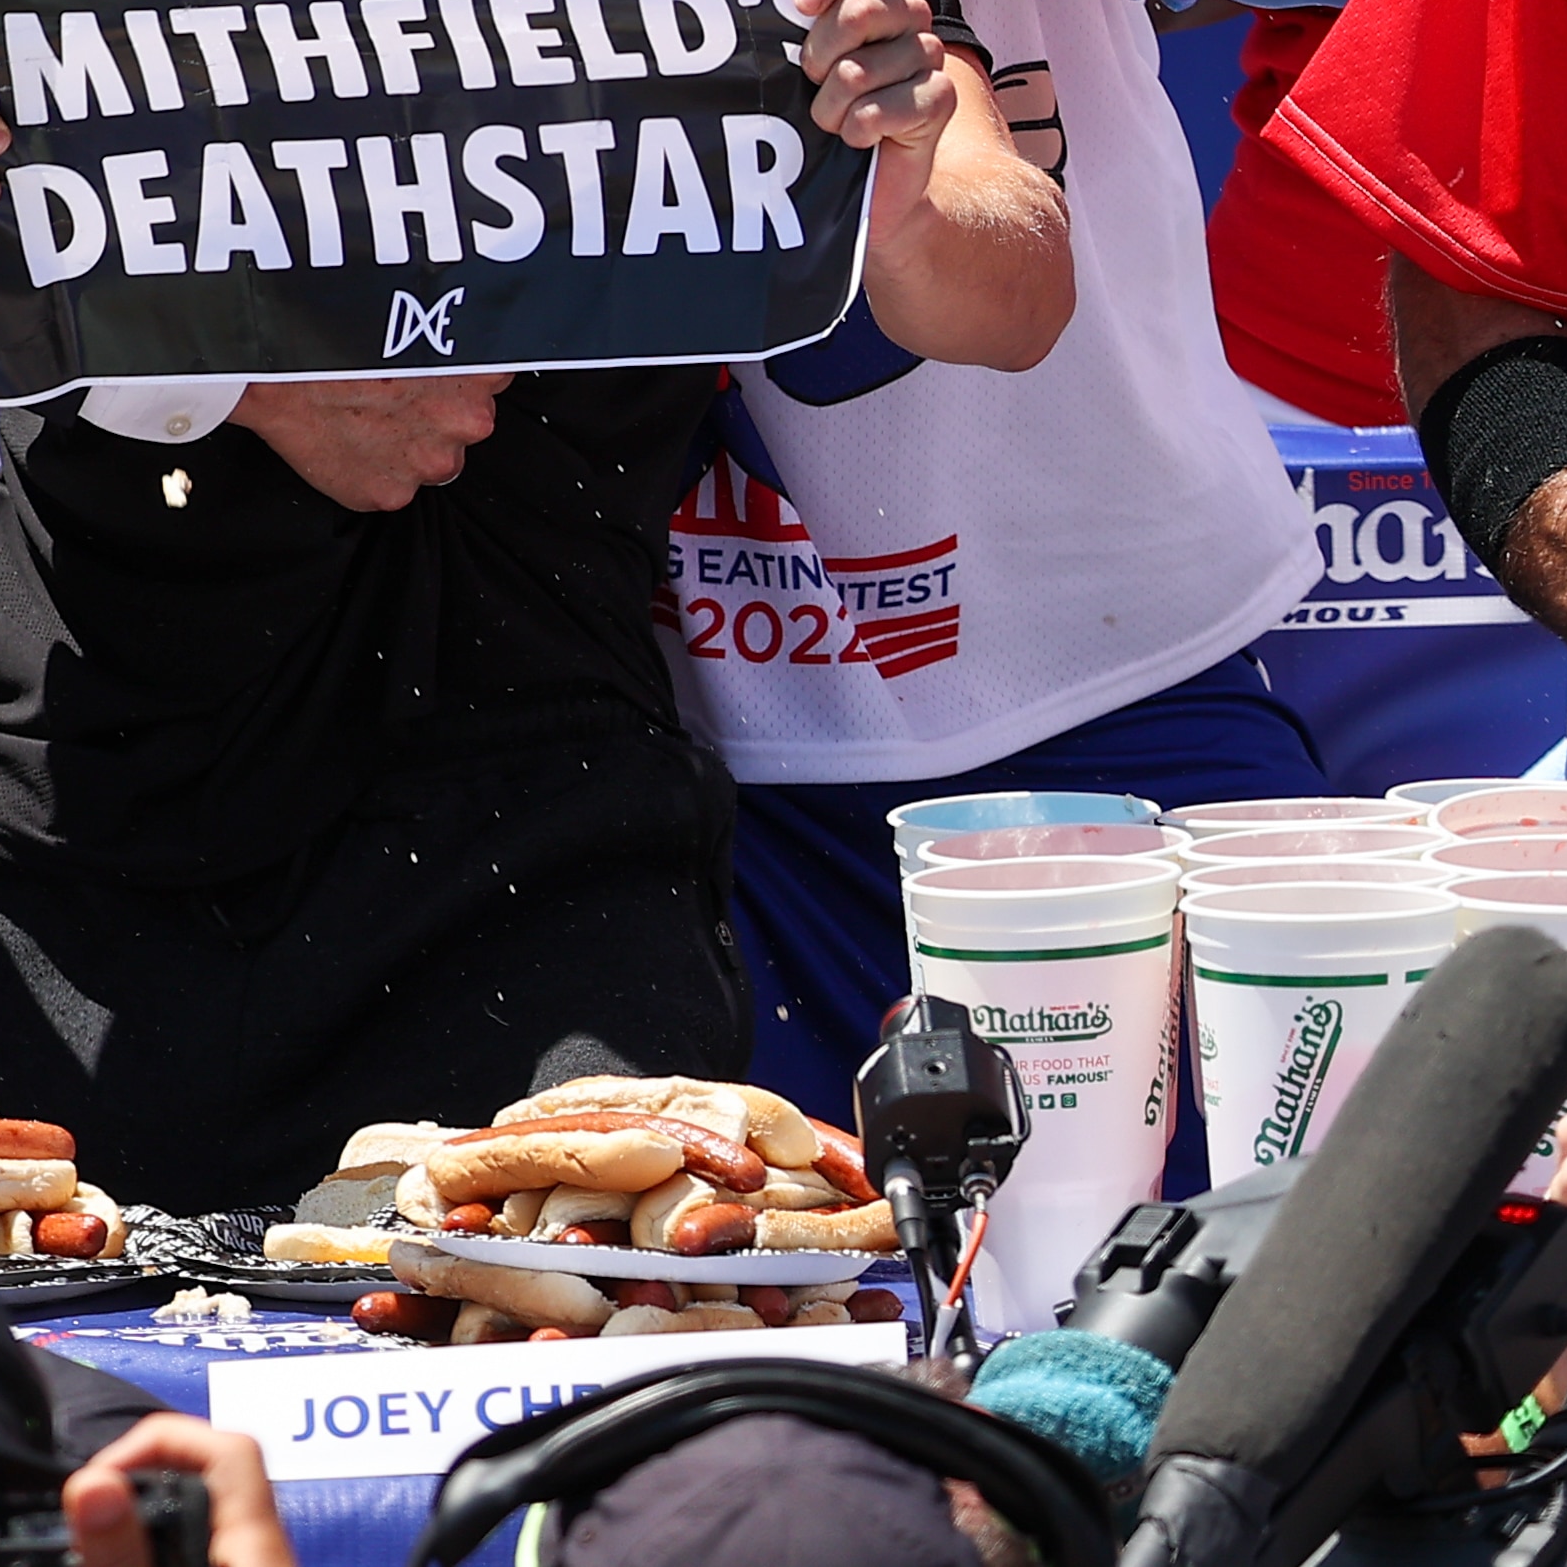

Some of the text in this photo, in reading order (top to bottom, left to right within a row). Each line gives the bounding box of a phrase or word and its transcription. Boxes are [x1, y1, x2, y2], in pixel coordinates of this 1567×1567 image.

[5, 112, 806, 289] DEATHSTAR
[1348, 470, 1414, 492] Since
[697, 547, 831, 590] EATIN
[1282, 605, 1408, 624] MOUS
[972, 1002, 1113, 1034] Nathan's
[1033, 1058, 1073, 1071] FOOD
[1077, 1055, 1111, 1068] THAT
[1023, 1073, 1041, 1086] US
[1254, 998, 1343, 1166] Nathan's
[292, 1388, 453, 1443] JOEY
